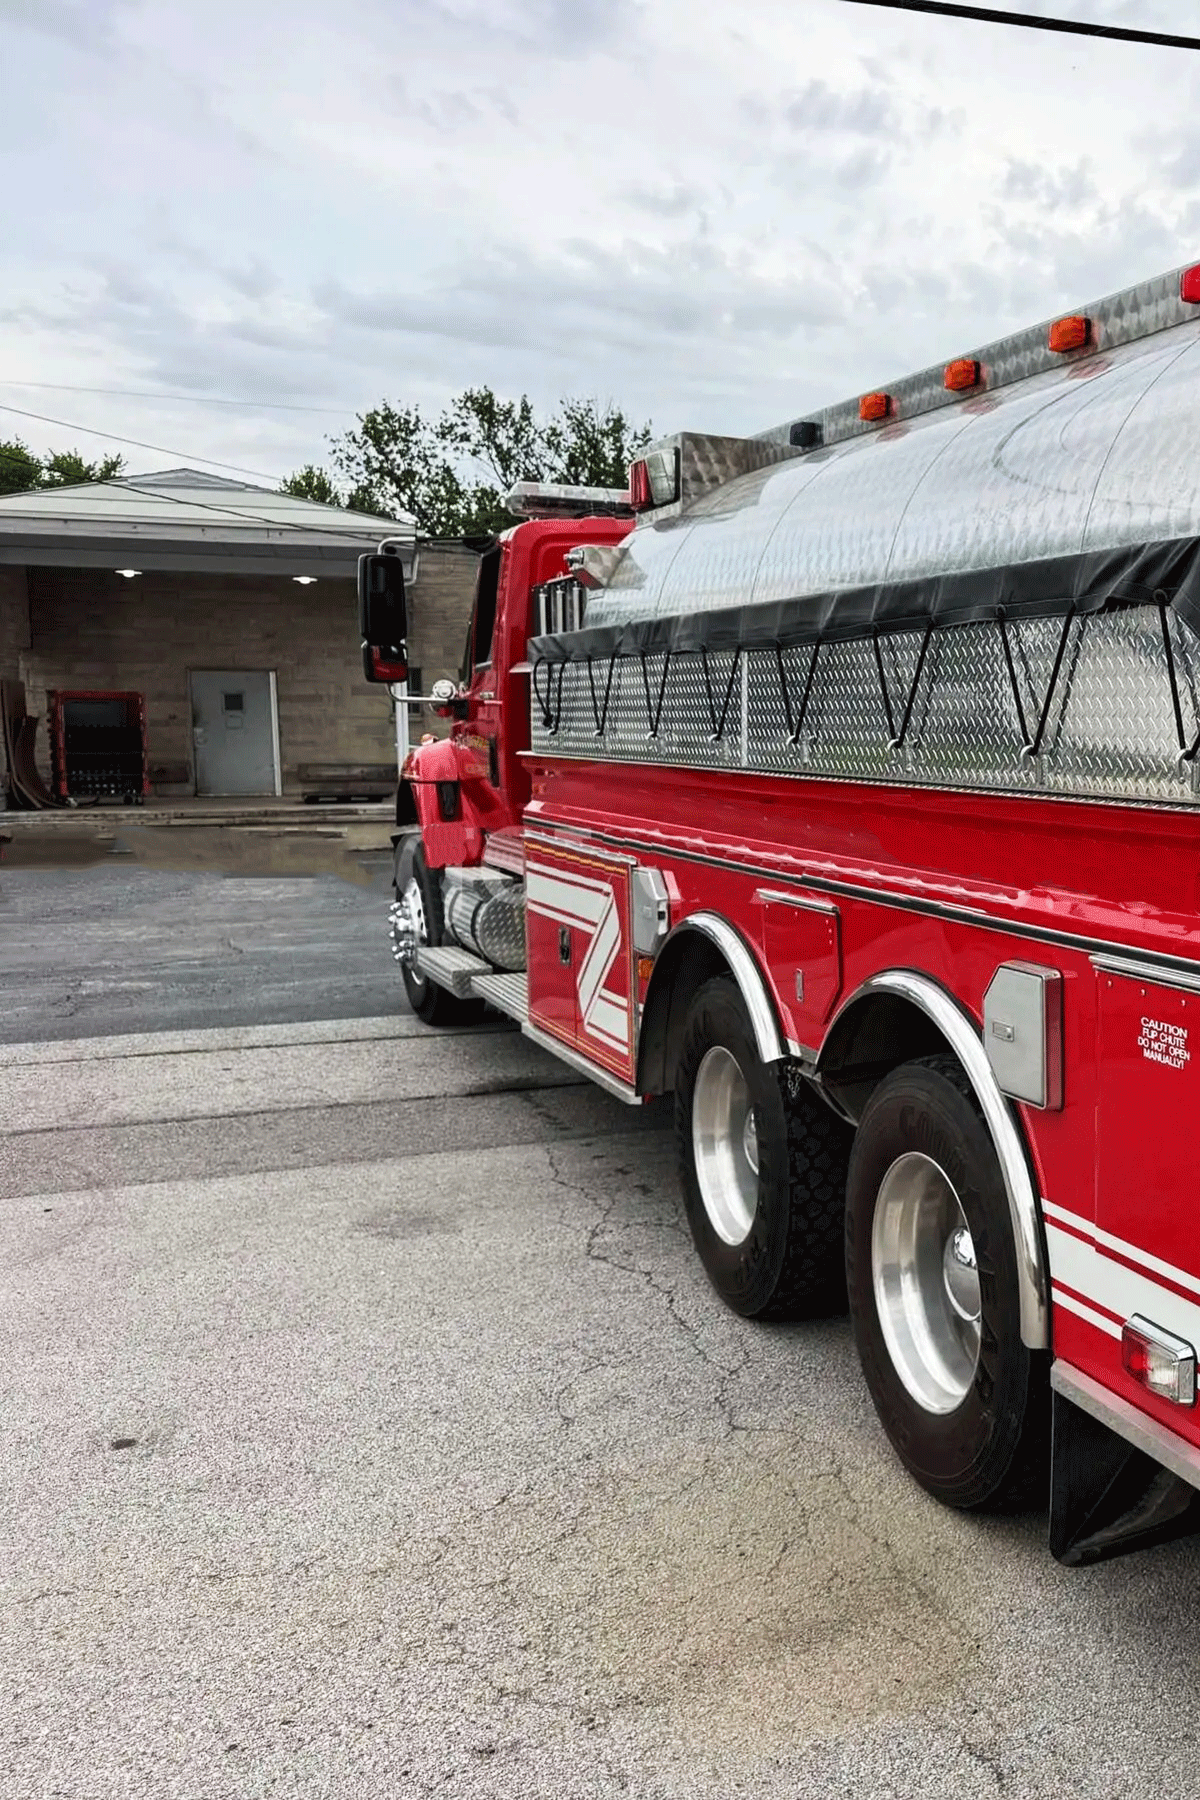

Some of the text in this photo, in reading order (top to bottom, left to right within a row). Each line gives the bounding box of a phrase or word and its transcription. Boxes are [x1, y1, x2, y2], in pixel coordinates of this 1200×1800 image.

[1140, 1016, 1188, 1039] CAUTION
[1142, 1027, 1186, 1049] FLIP CHUTE
[1137, 1036, 1191, 1061] DO NOT OPEN
[1143, 1048, 1185, 1070] MANUALLY!
